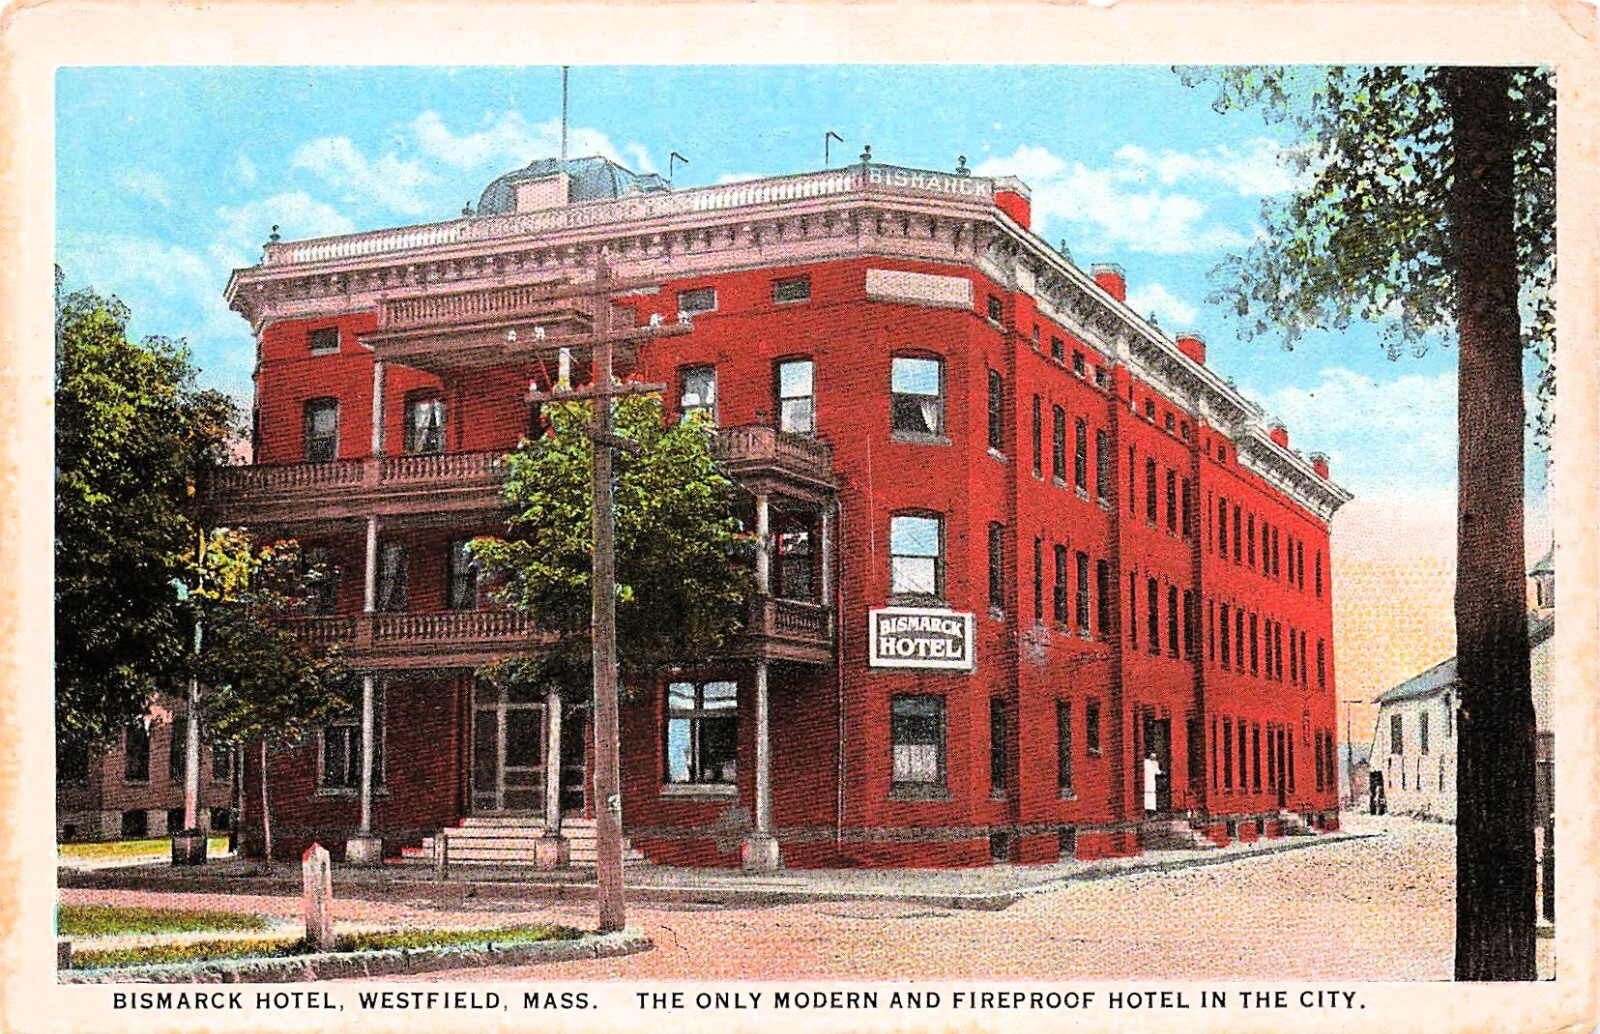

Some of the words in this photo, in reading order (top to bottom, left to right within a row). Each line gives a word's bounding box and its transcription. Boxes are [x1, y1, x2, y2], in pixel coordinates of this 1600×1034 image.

[868, 167, 988, 197] BISMARCK
[879, 616, 963, 638] BISMARCK
[879, 637, 962, 658] HOTEL
